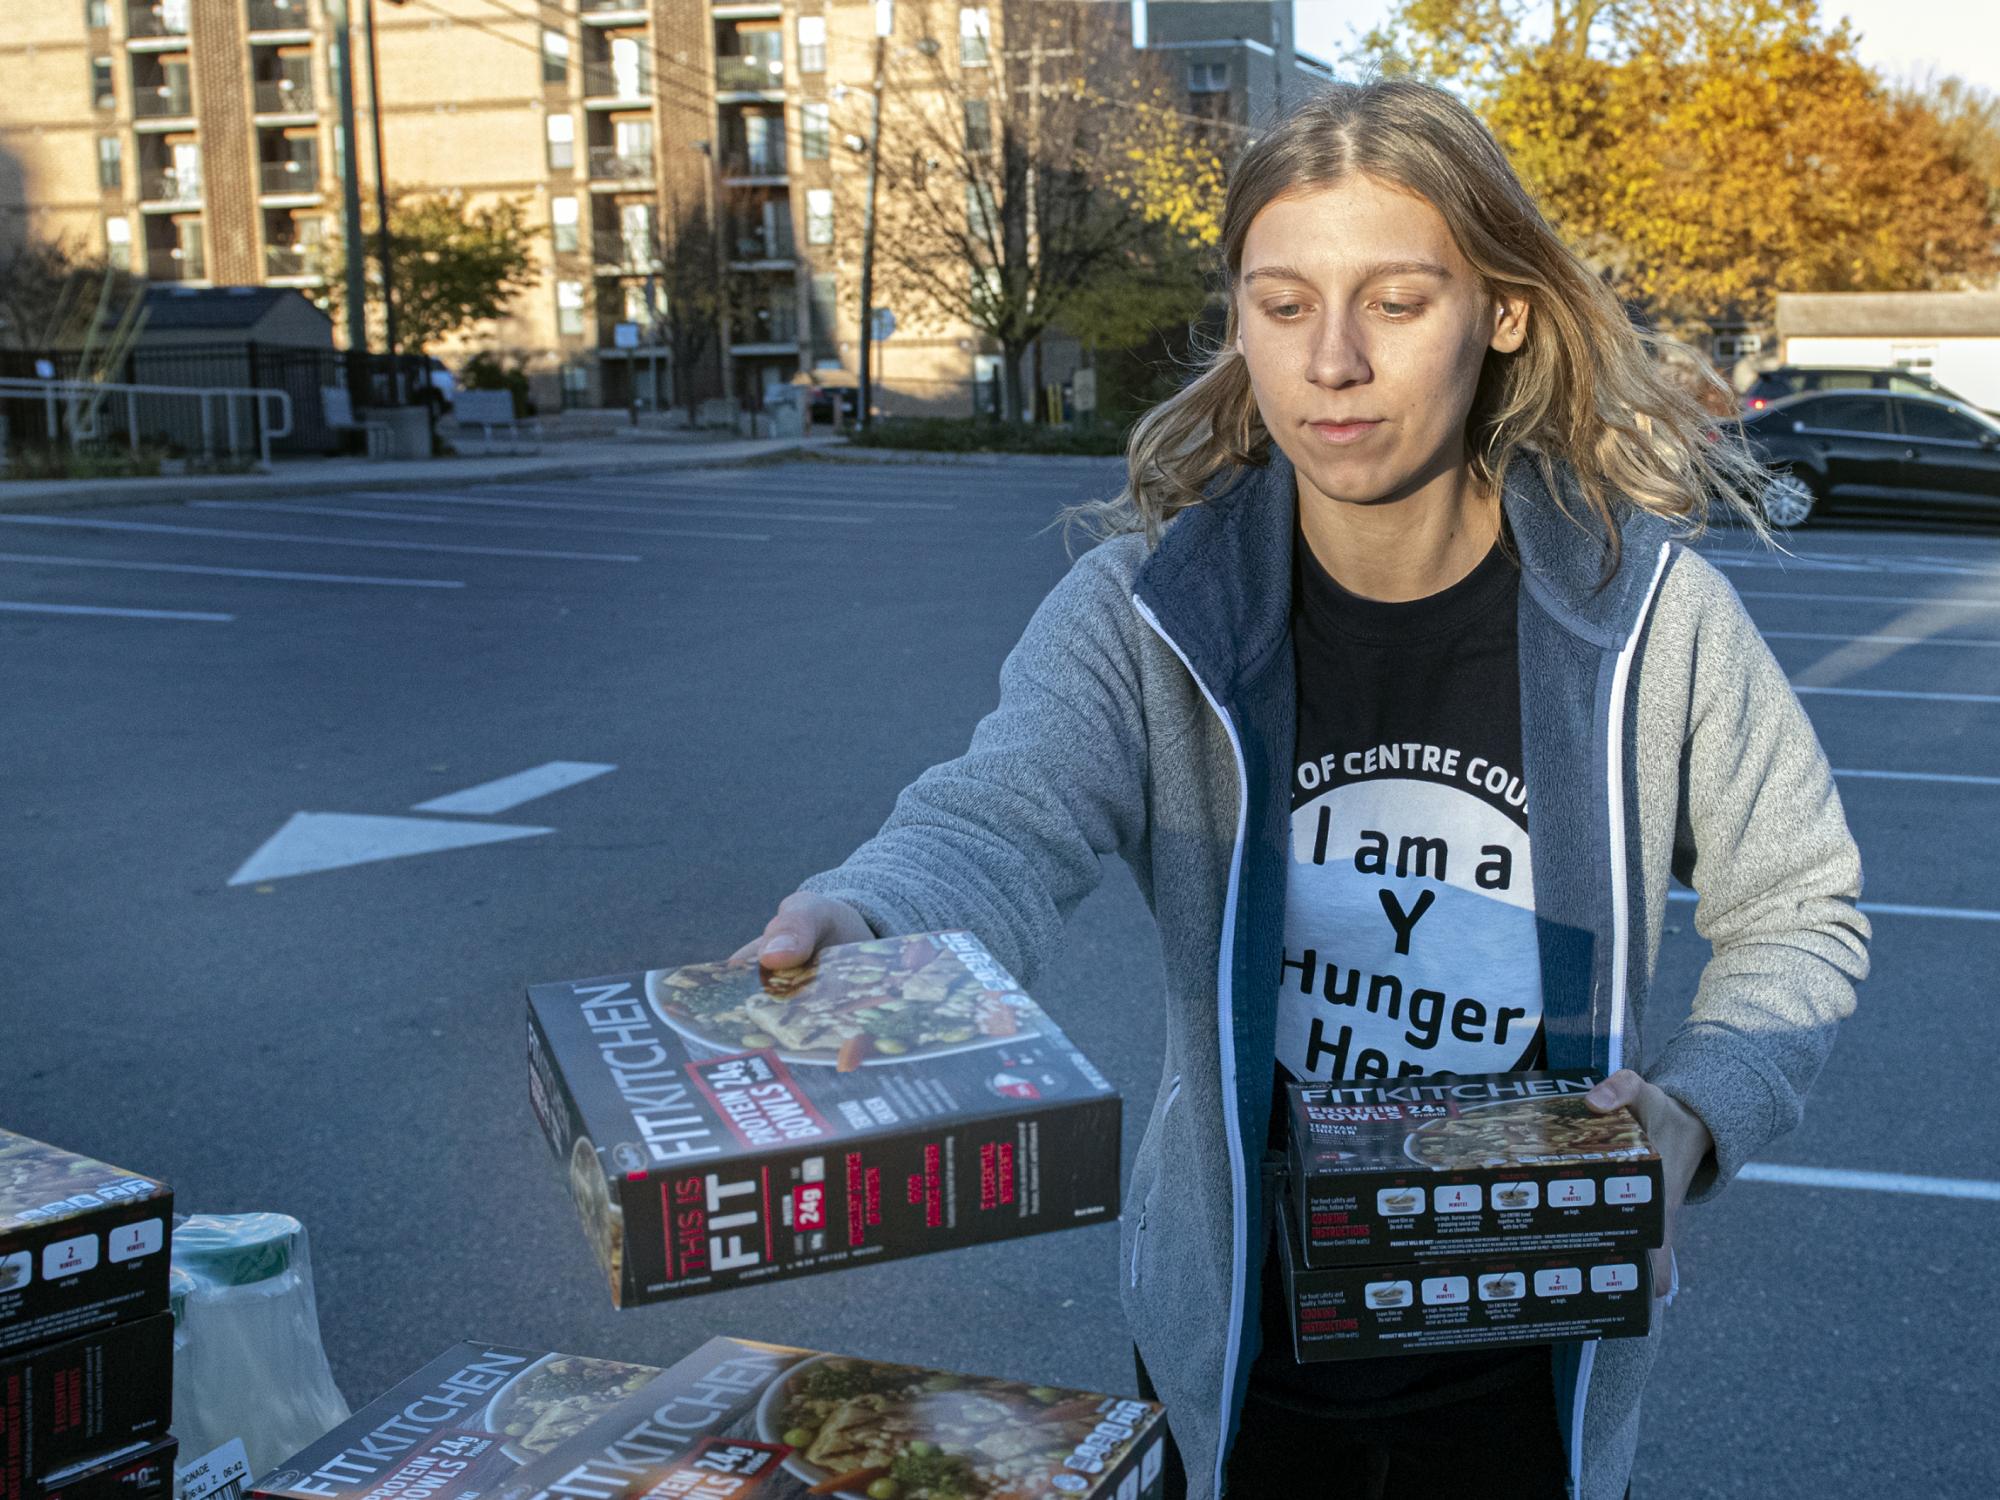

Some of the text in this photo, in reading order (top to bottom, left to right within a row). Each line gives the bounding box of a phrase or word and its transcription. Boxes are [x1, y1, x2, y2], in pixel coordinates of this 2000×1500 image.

[1297, 743, 1528, 814] OF CENTRE COU
[1313, 805, 1512, 890] I am a
[1378, 889, 1436, 956] Y
[1280, 947, 1526, 1050] Hunger
[1305, 1017, 1459, 1081] Her
[573, 982, 720, 1162] FITKITCHEN
[1301, 1076, 1596, 1104] FITKITCHEN
[716, 1090, 783, 1146] PROTEIN
[751, 1083, 823, 1139] BOWLS
[1306, 1104, 1446, 1114] PROTEIN 24g
[1309, 1112, 1403, 1121] BOWLS
[675, 1176, 703, 1204] IS
[799, 1188, 822, 1225] 24g
[1456, 1192, 1461, 1200] 4
[1569, 1186, 1574, 1195] 2
[705, 1173, 760, 1272] FIT
[68, 1247, 74, 1258] 2
[679, 1209, 705, 1276] THIS
[1443, 1283, 1448, 1292] 4
[1555, 1275, 1560, 1284] 2
[289, 1352, 527, 1498] FITKITCHEN
[430, 1436, 480, 1456] 24g
[693, 1446, 754, 1472] 24g
[183, 1462, 210, 1484] ONADE
[393, 1460, 468, 1500] OWLS
